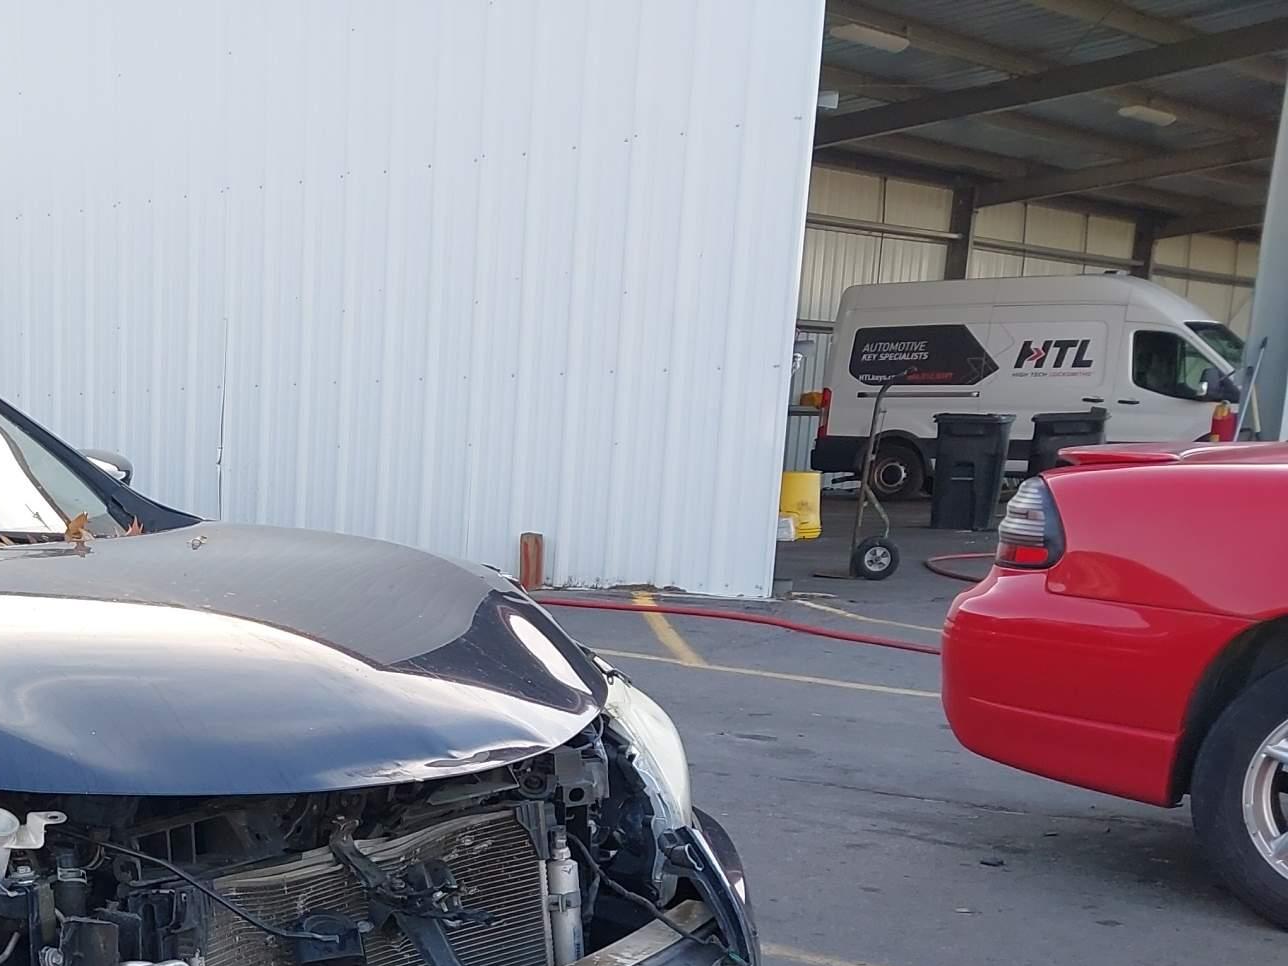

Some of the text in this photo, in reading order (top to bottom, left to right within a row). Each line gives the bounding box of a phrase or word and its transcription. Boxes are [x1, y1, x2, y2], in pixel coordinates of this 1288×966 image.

[861, 340, 929, 353] AUTOMOTIVE
[861, 352, 929, 361] KEY SPECIALISTS
[1013, 339, 1094, 369] HTL
